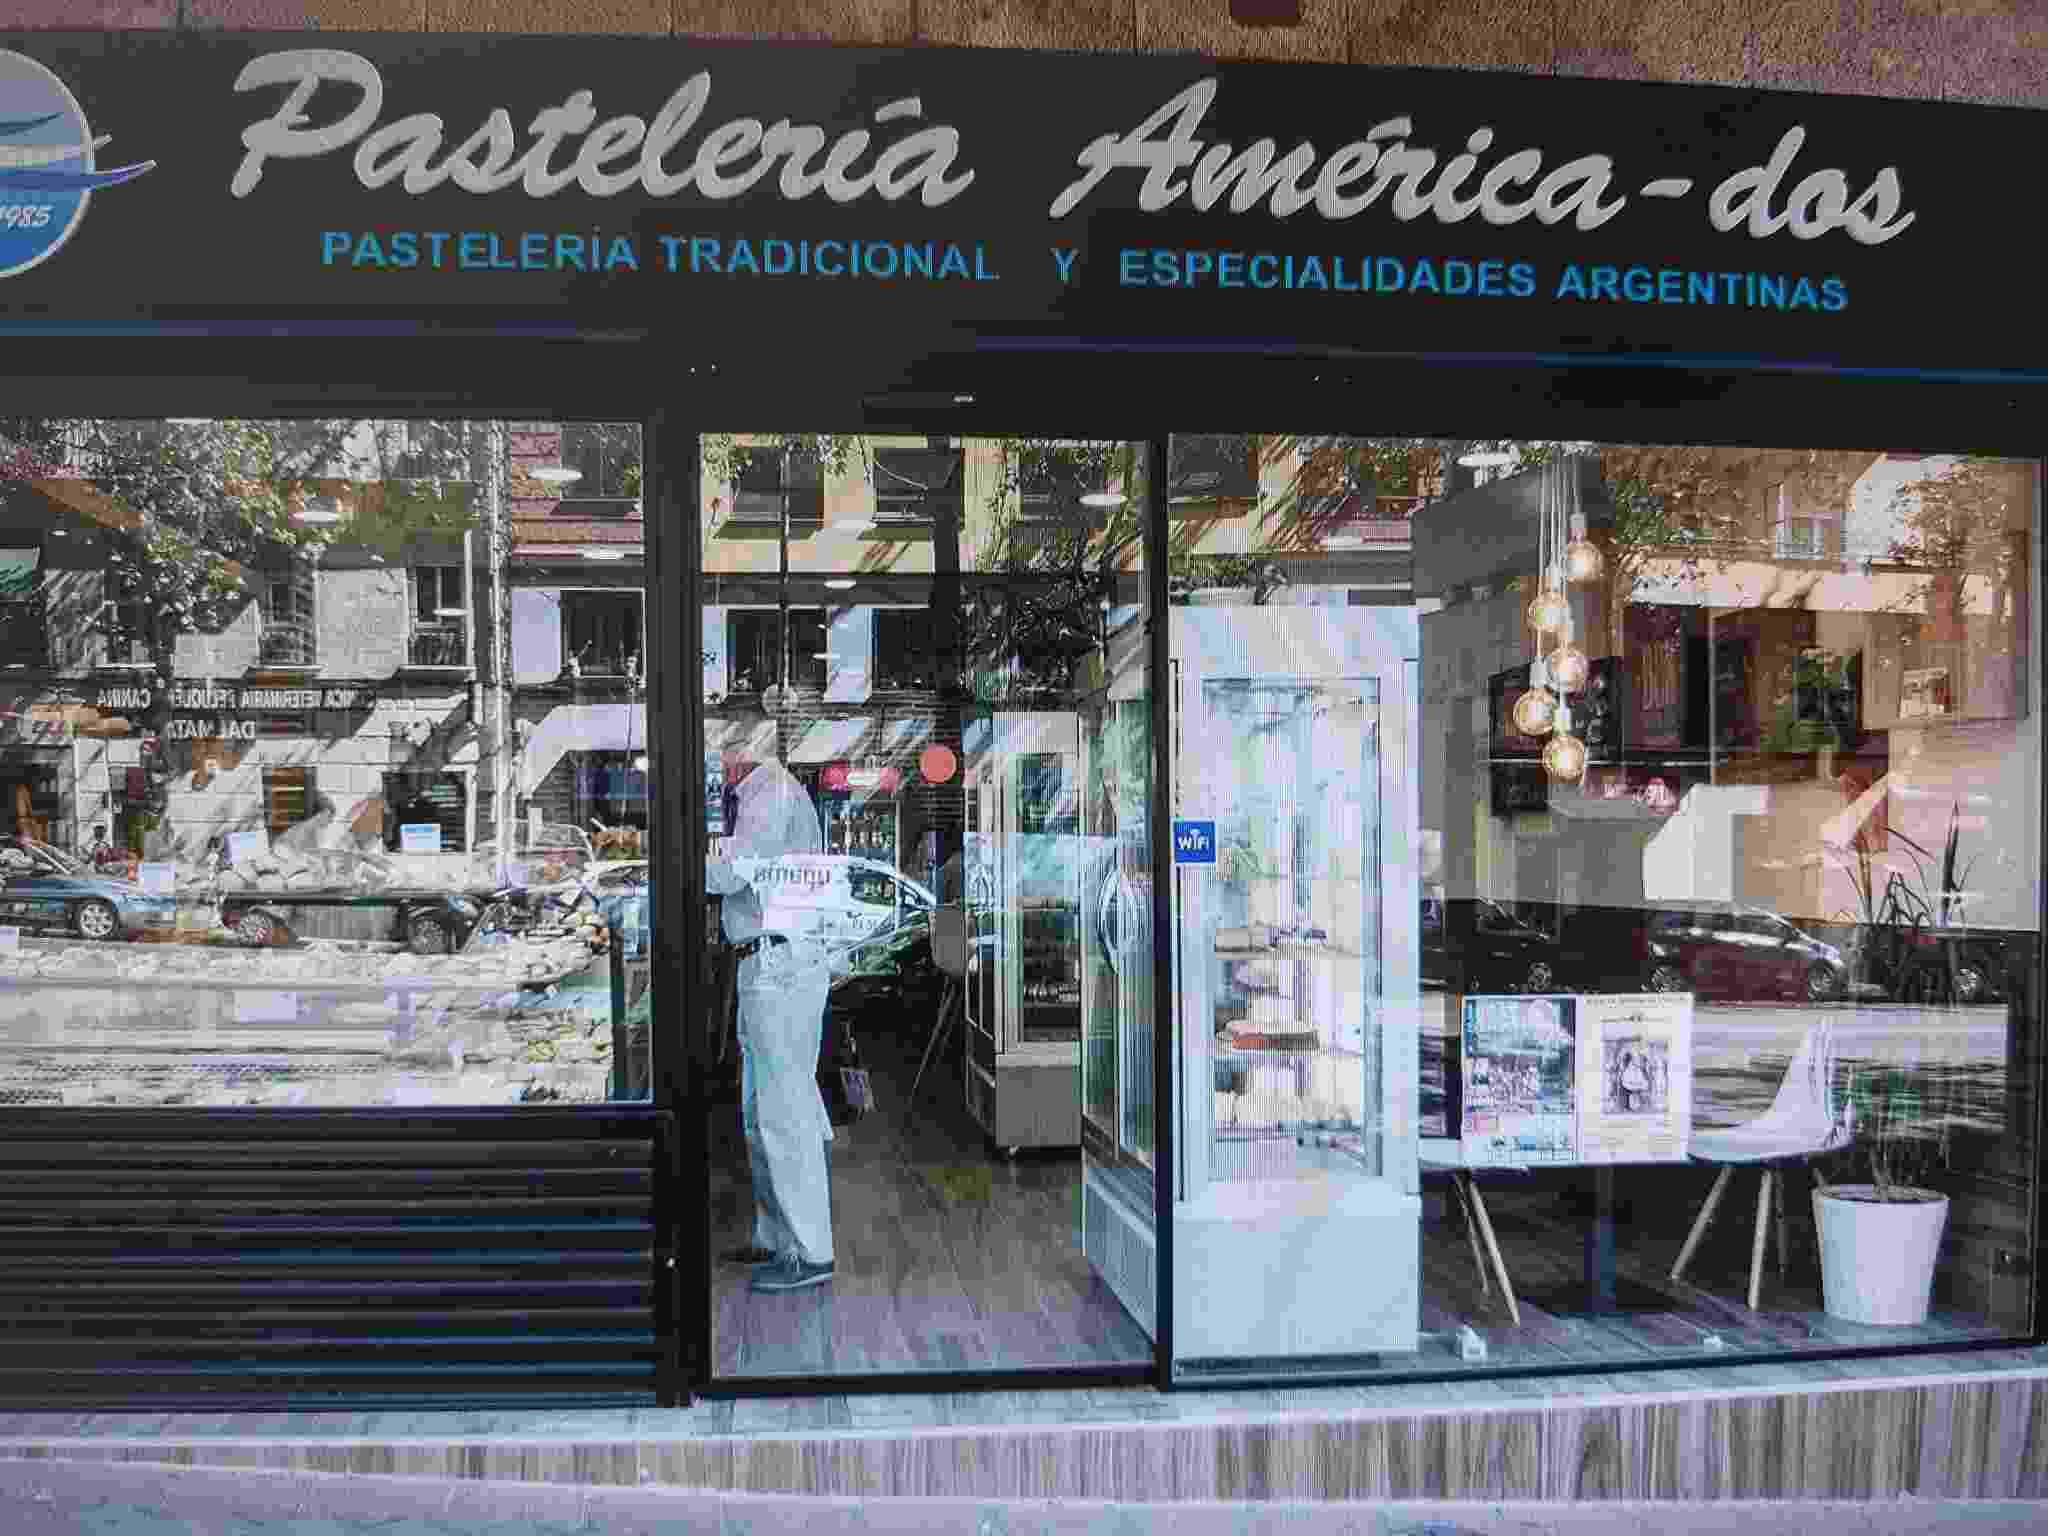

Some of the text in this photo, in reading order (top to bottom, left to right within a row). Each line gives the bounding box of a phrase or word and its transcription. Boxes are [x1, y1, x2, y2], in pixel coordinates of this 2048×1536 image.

[229, 48, 976, 207] Pastelería
[657, 234, 1000, 281] TRADICIONAL
[1050, 247, 1080, 284] Y
[1119, 248, 1537, 298] ESPECIALIDADES
[1555, 264, 1850, 311] ARGENTINAS
